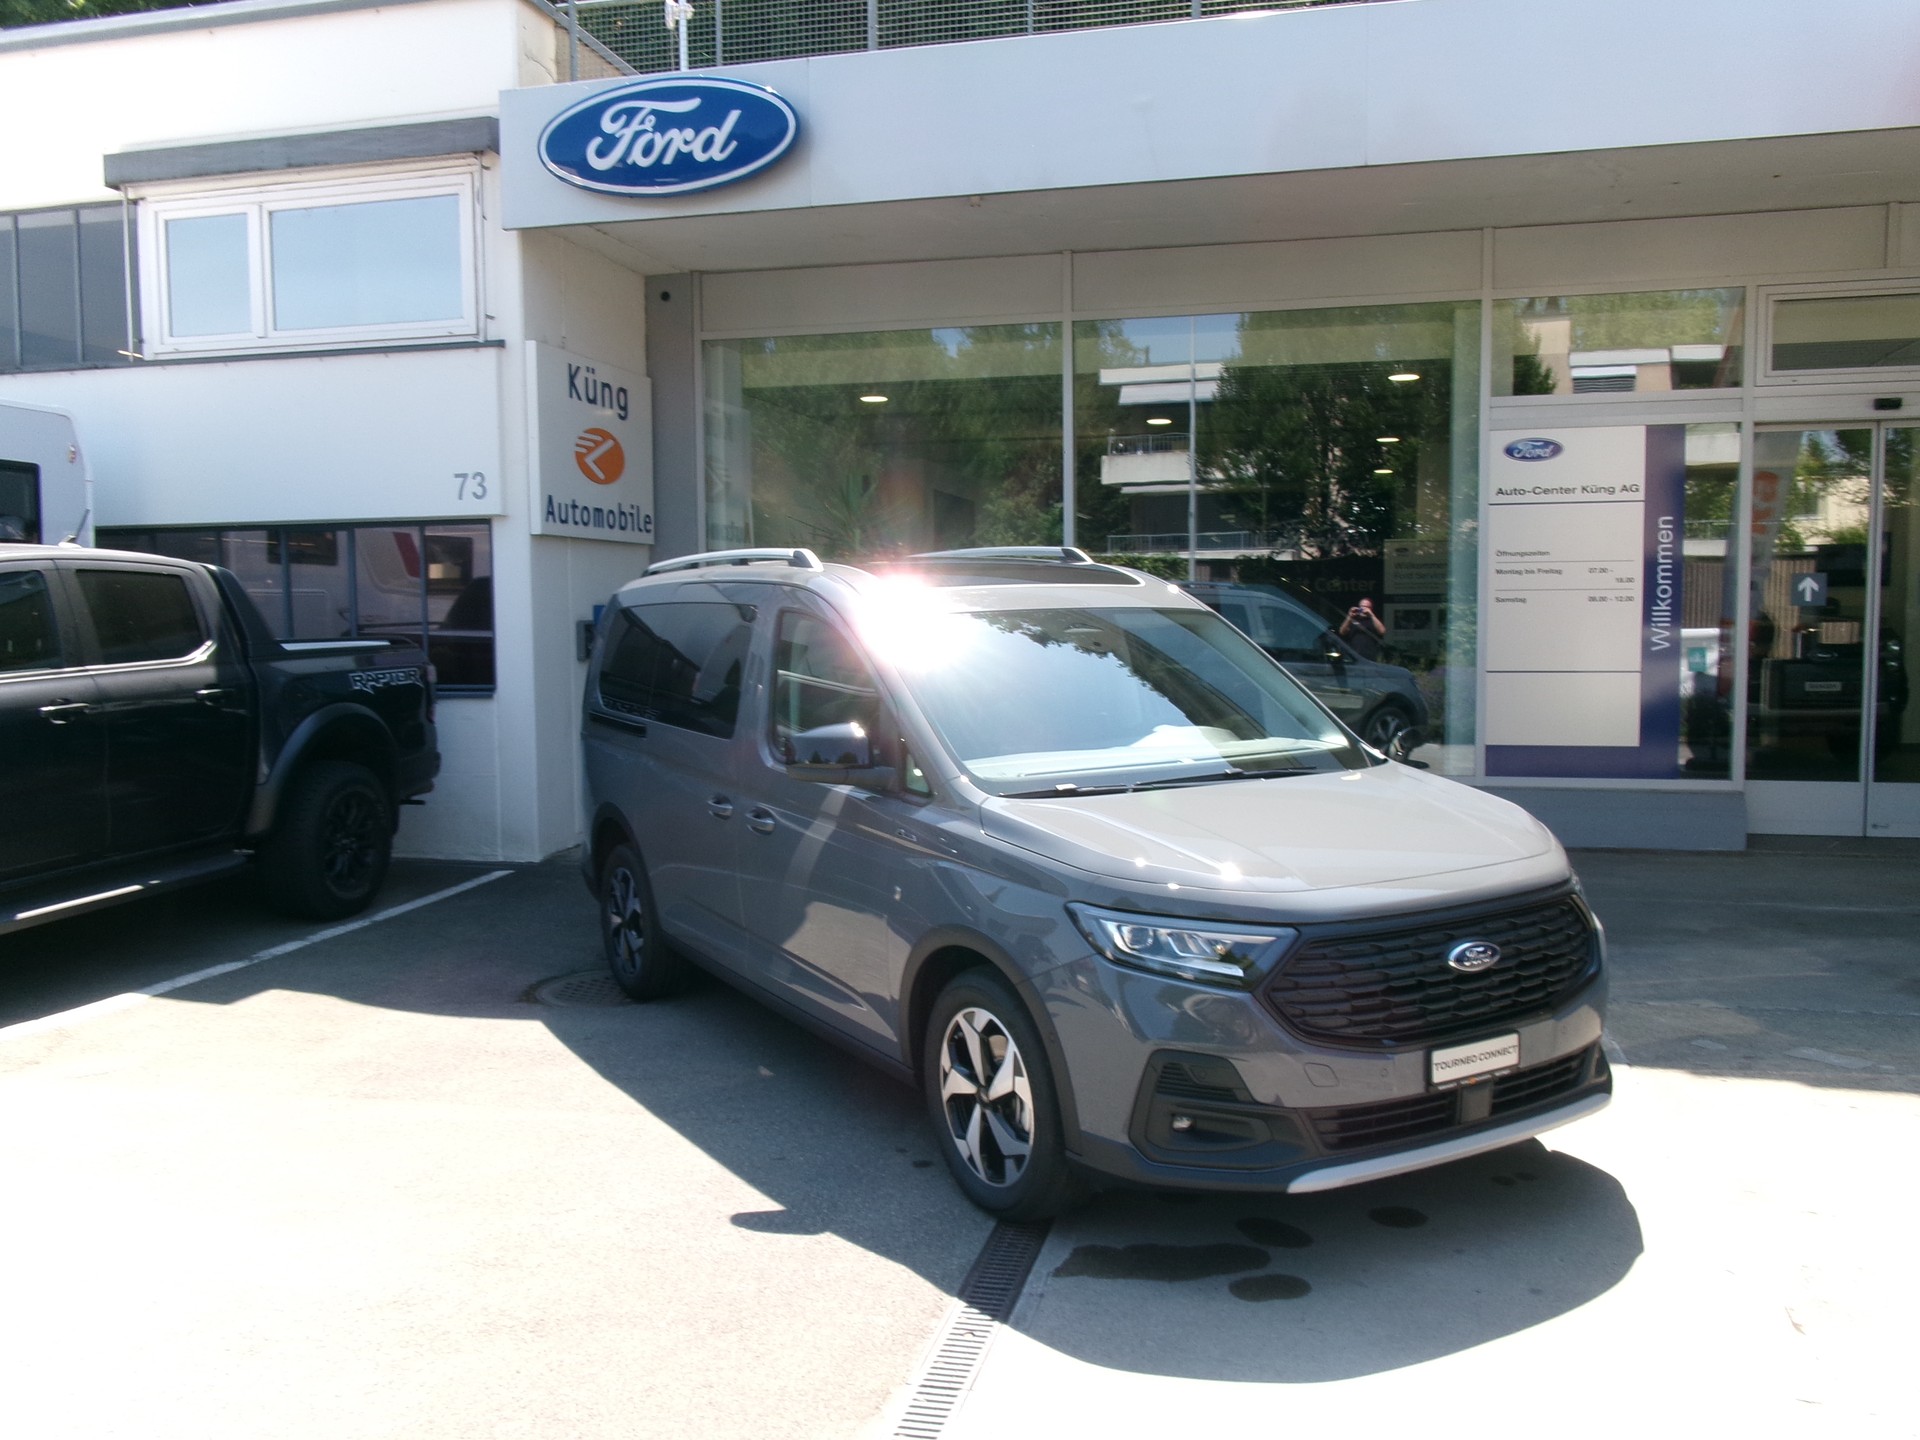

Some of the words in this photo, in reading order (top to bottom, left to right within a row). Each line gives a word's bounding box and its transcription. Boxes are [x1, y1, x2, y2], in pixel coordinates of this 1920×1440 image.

[586, 97, 742, 170] Ford
[567, 363, 629, 421] Küng
[1512, 441, 1555, 458] Ford
[454, 471, 487, 500] 73
[1495, 486, 1577, 496] Auto-Center
[1581, 484, 1616, 495] Küng
[1620, 484, 1640, 493] AG
[545, 494, 653, 533] Automobile
[1495, 550, 1551, 558] Öffnungszeiten
[1496, 568, 1523, 576] Montag
[1651, 516, 1674, 651] Willkommen
[348, 667, 425, 694] RAPTOR
[1433, 1054, 1478, 1071] TOURNEO
[1478, 1045, 1519, 1062] CONNECT
